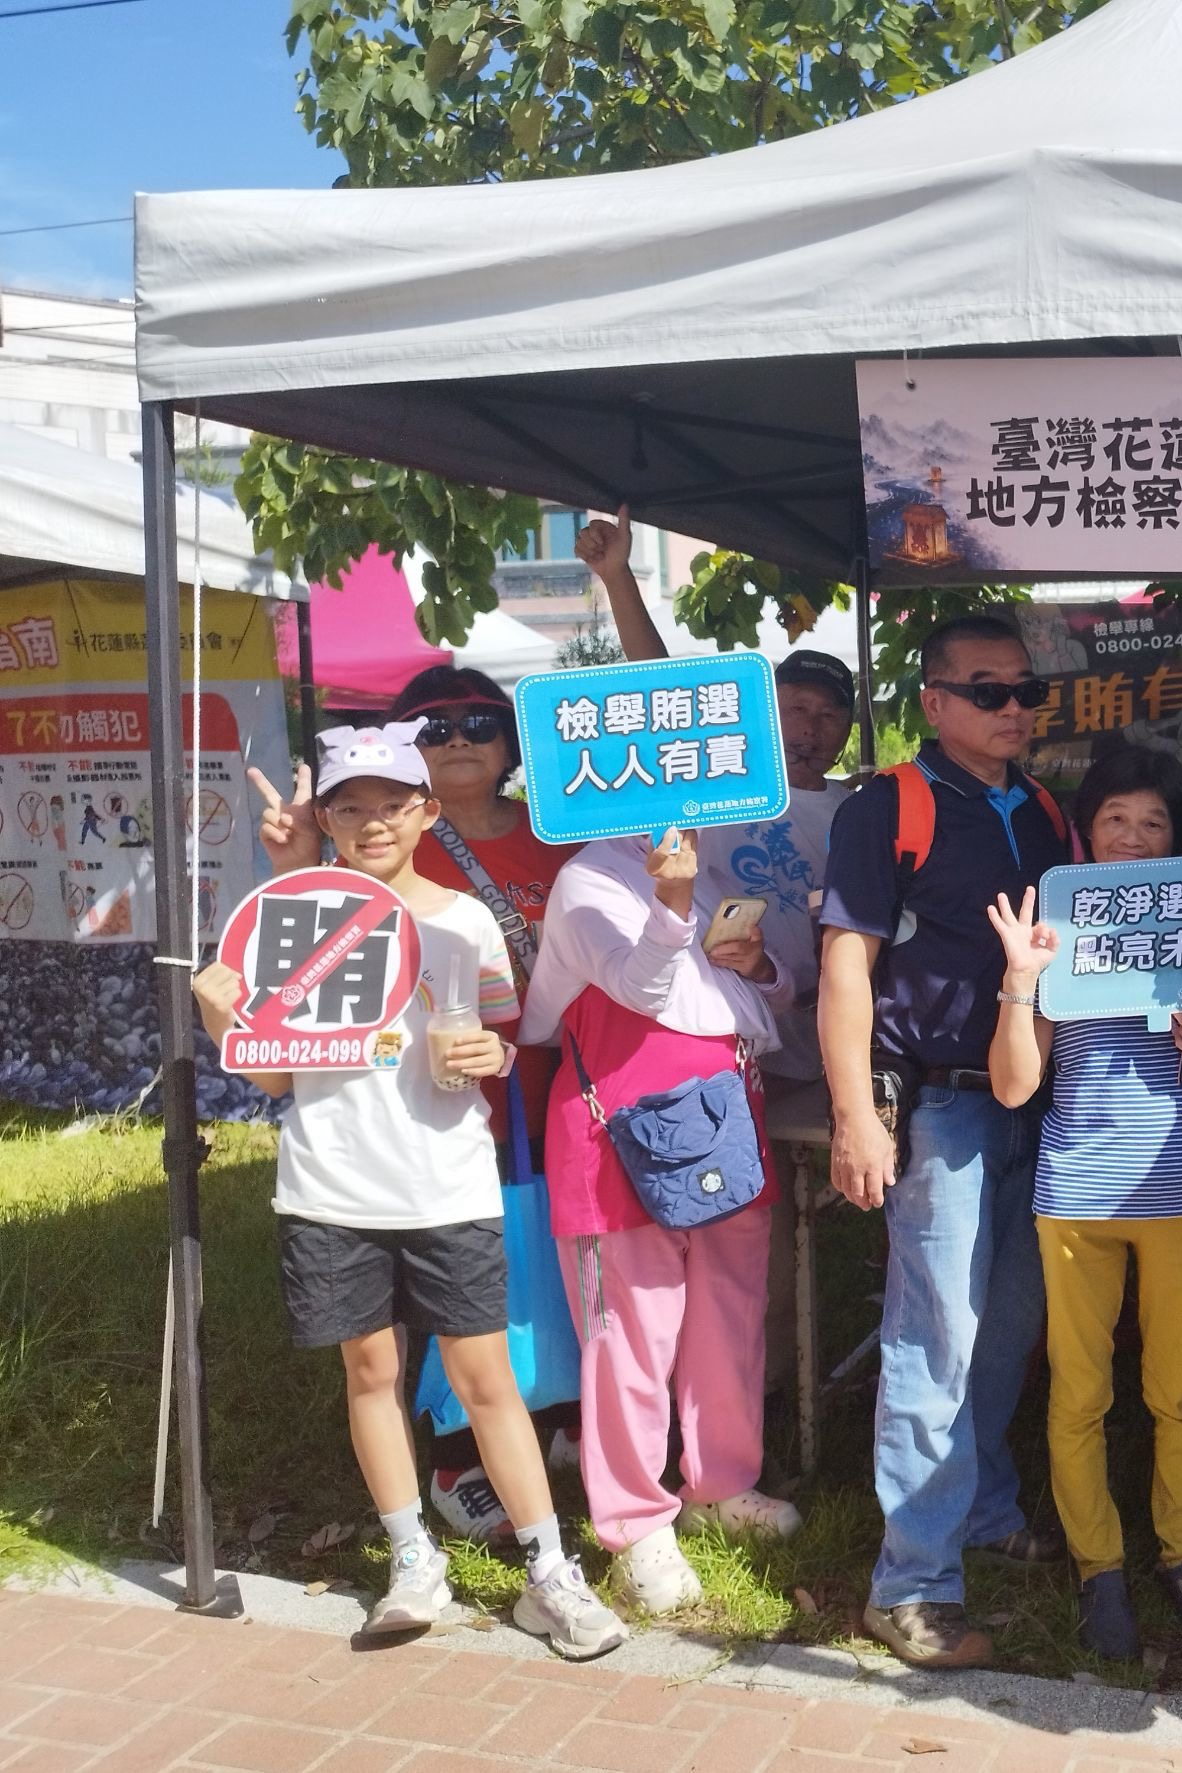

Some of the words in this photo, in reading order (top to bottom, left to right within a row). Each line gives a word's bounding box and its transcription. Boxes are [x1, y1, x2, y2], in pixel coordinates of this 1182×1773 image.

[1094, 618, 1154, 637] 檢舉專線
[555, 682, 741, 742] 檢舉賄選
[564, 733, 748, 797] 人人有責
[246, 895, 400, 1024] 賄
[235, 1039, 362, 1065] 0800-024-099
